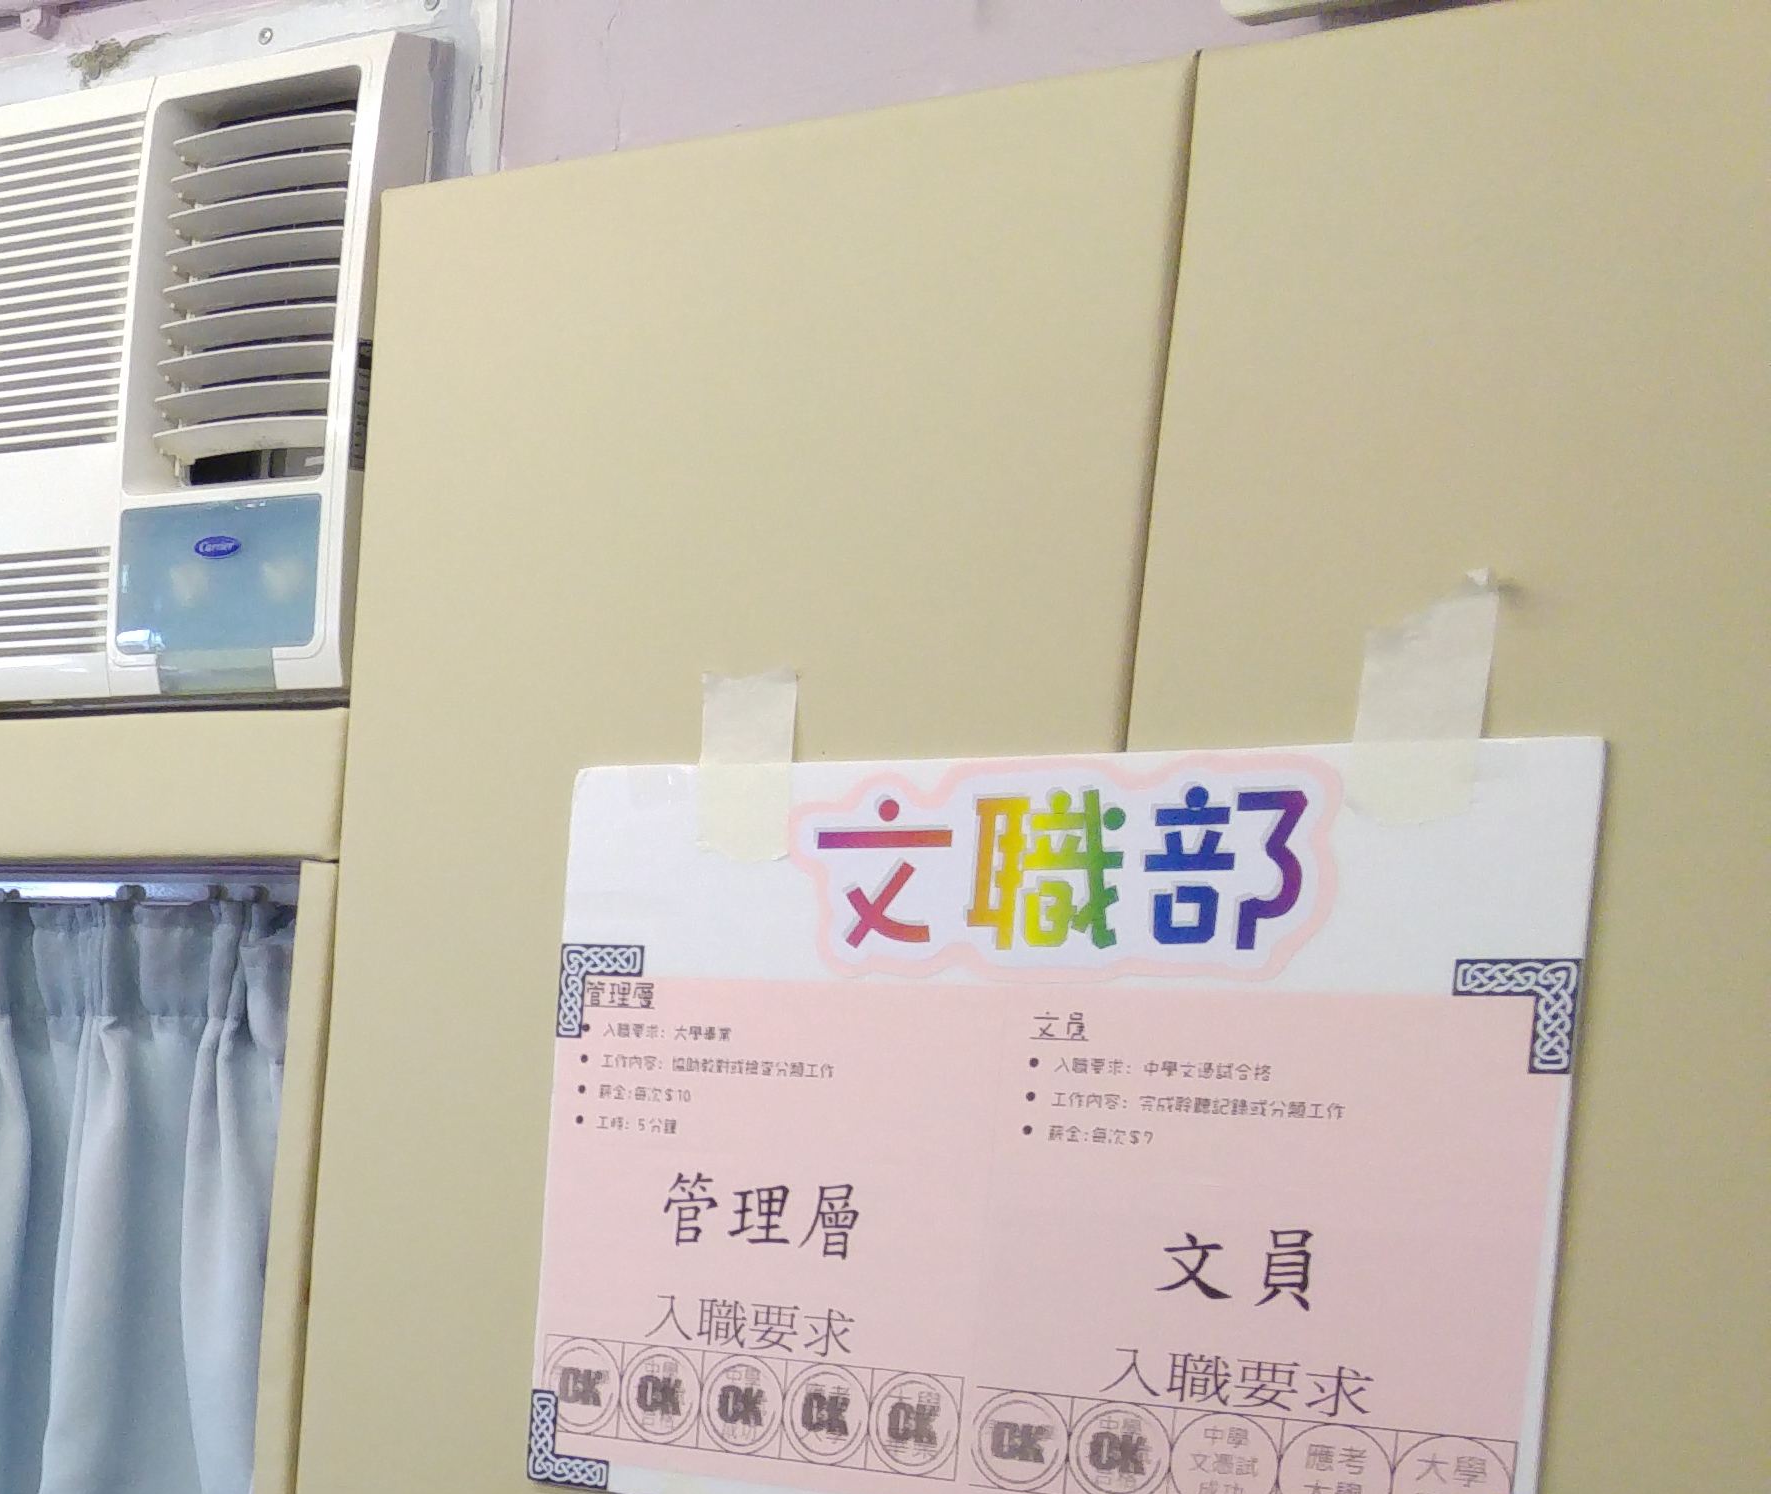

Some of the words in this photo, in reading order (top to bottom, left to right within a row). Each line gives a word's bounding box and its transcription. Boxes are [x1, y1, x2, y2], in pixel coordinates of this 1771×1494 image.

[816, 785, 1310, 952] 文職部
[586, 980, 656, 1008] 管理層
[1032, 1011, 1087, 1039] 文員
[663, 1171, 860, 1260] 管理層
[1154, 1229, 1314, 1311] 文員
[644, 1295, 856, 1357] 入職要求
[1098, 1346, 1374, 1418] 入職要求
[1202, 1425, 1251, 1449] 中學
[1188, 1451, 1260, 1478] 文憑試
[1305, 1442, 1368, 1477] 應考
[1415, 1451, 1489, 1490] 大學
